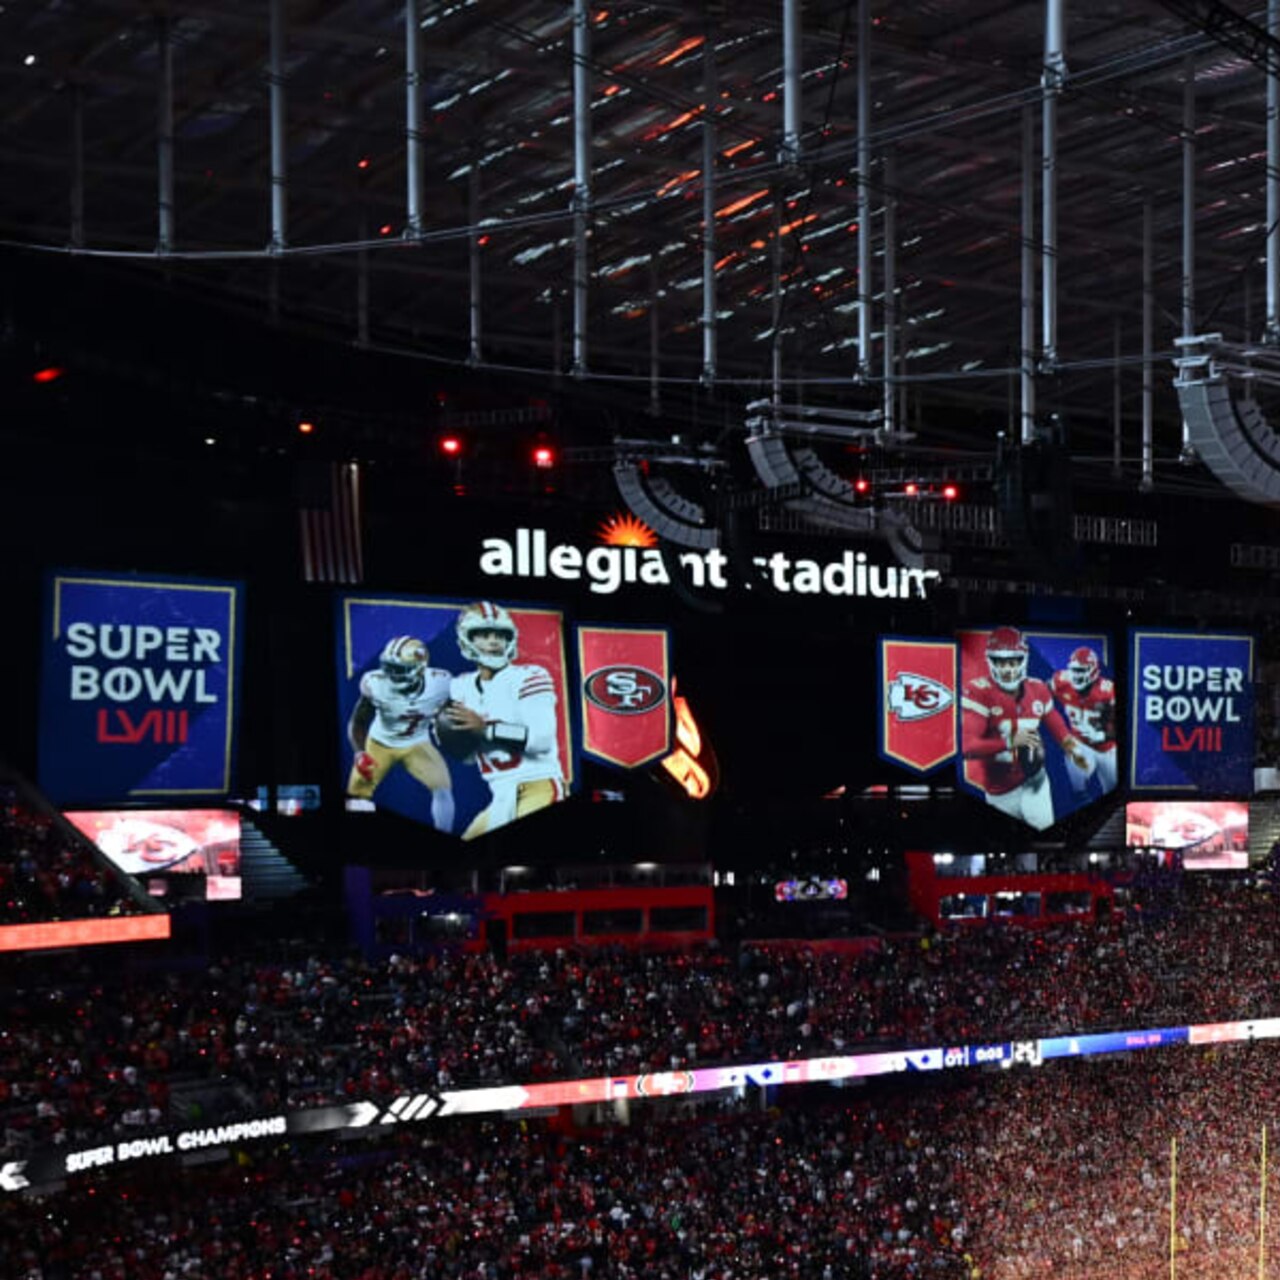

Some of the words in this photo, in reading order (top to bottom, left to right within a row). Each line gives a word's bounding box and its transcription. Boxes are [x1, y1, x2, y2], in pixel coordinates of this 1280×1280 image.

[66, 622, 221, 662] SUPER
[70, 665, 218, 703] BOWL
[1142, 664, 1244, 692] SUPER
[96, 708, 189, 744] LVIII
[1144, 697, 1241, 723] BOWL
[1161, 727, 1222, 752] LVIII
[65, 1145, 114, 1173] SUPER
[117, 1136, 174, 1161] BOWL
[176, 1116, 288, 1150] CHAMPIONS
